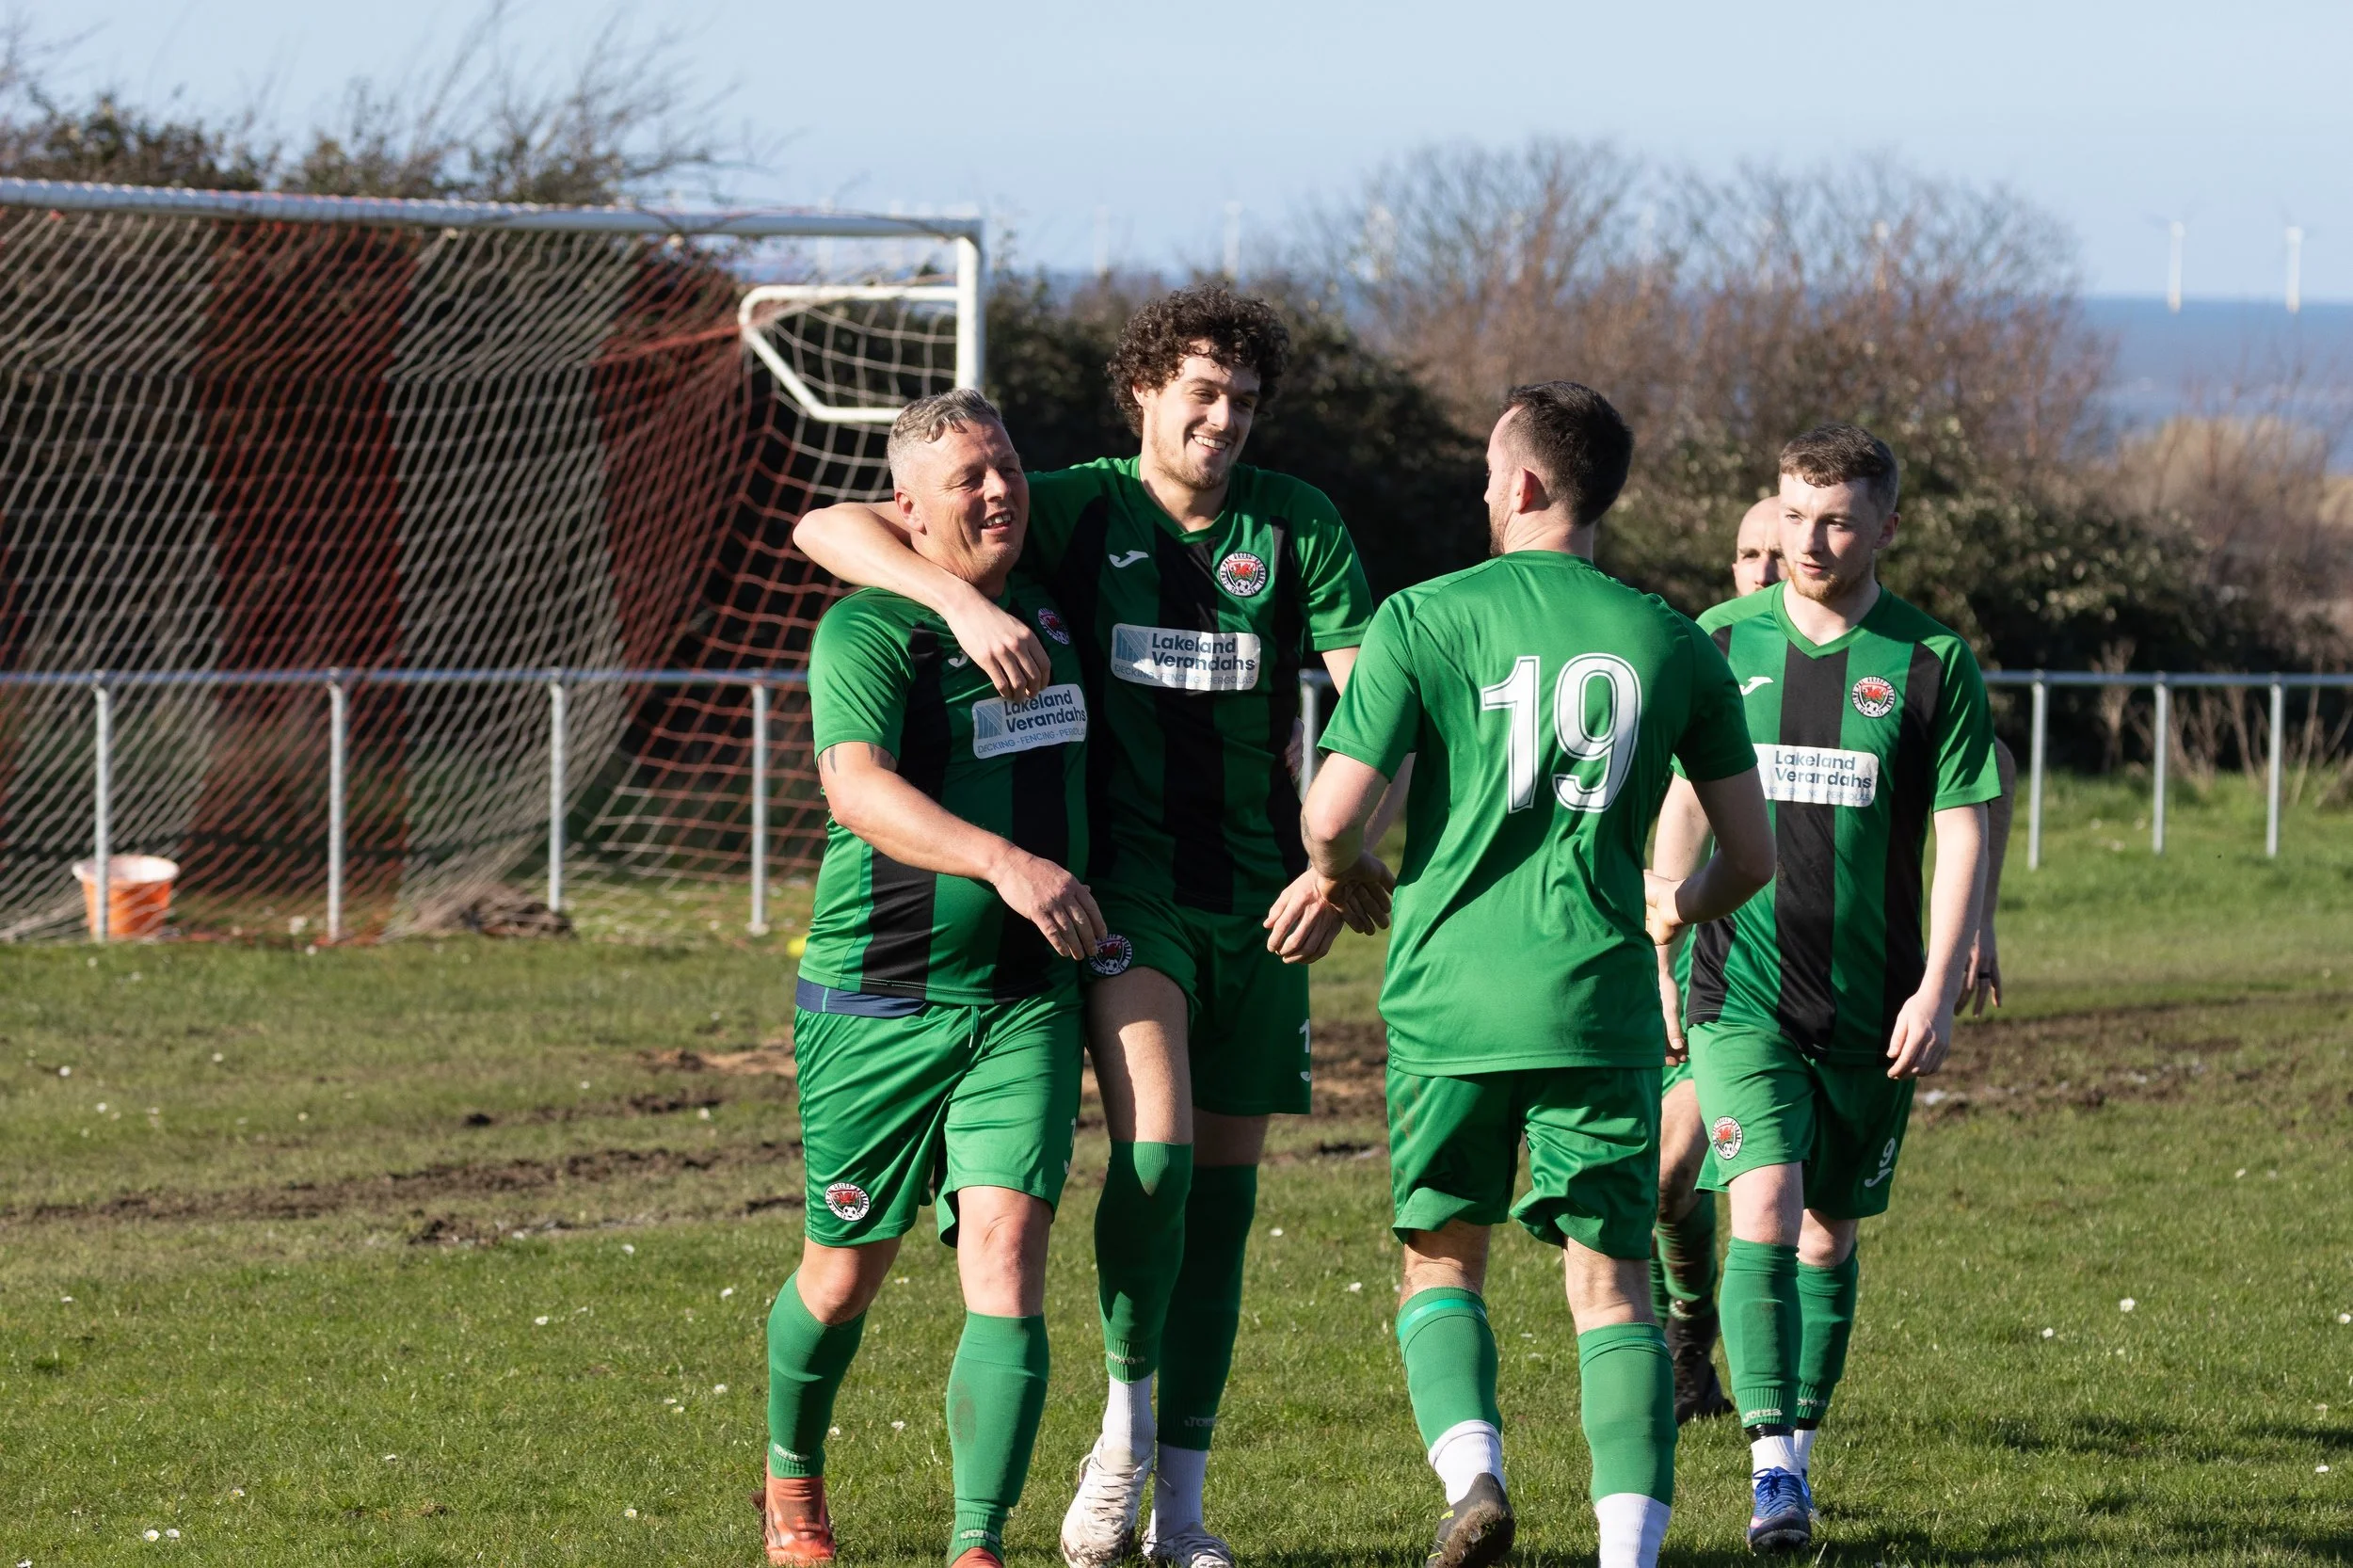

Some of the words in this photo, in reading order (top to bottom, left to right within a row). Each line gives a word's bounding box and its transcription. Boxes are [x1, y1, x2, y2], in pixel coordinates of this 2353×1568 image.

[1151, 632, 1236, 654] Lakeland
[1114, 664, 1154, 680] DECKING
[1151, 650, 1256, 672] Verandahs
[1003, 689, 1073, 716] Lakeland
[1005, 707, 1086, 732] Verandahs
[978, 739, 1016, 753] DECKING
[1019, 730, 1055, 744] FENCING
[1481, 652, 1642, 814] 19
[1775, 750, 1855, 771] Lakeland
[1775, 767, 1872, 789] Verandahs
[1879, 1137, 1897, 1168] 9
